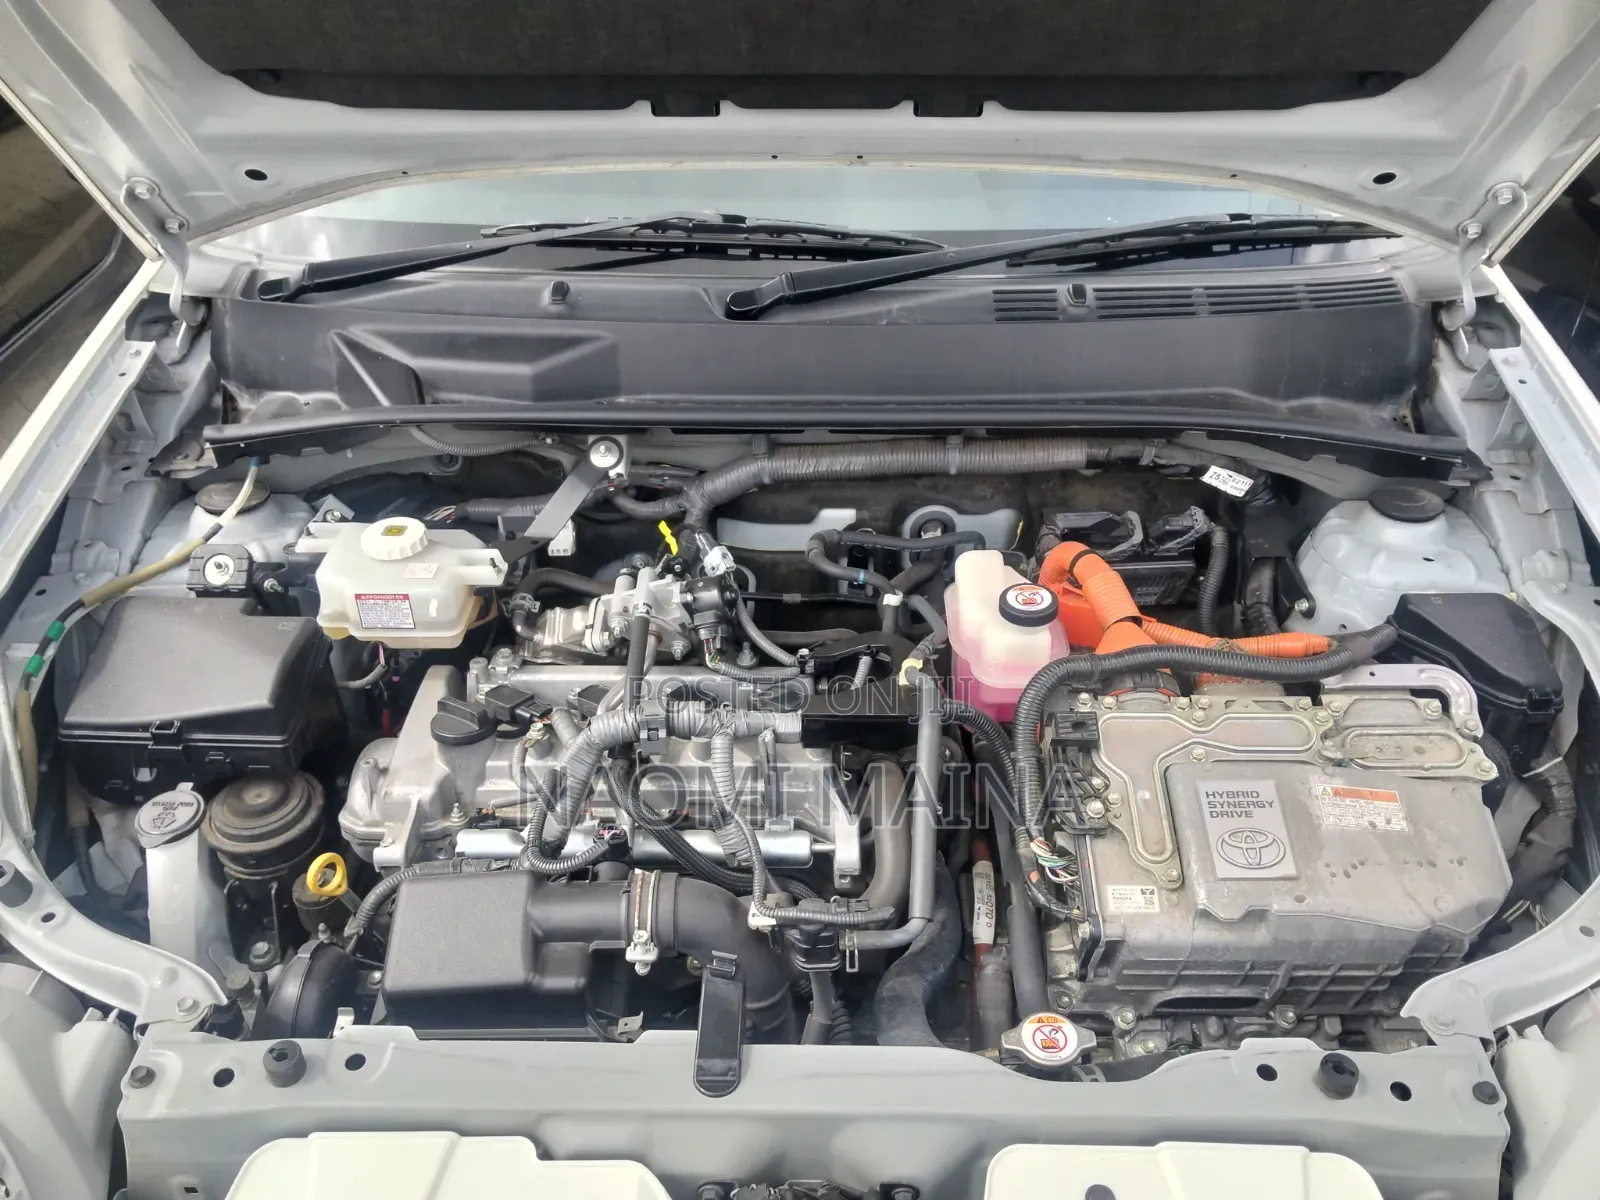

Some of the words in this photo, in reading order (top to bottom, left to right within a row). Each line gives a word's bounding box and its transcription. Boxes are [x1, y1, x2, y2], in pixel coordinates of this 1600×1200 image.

[1205, 790, 1260, 799] HYBRID
[1207, 800, 1275, 809] SYNERGY
[1209, 810, 1254, 819] DRIVE
